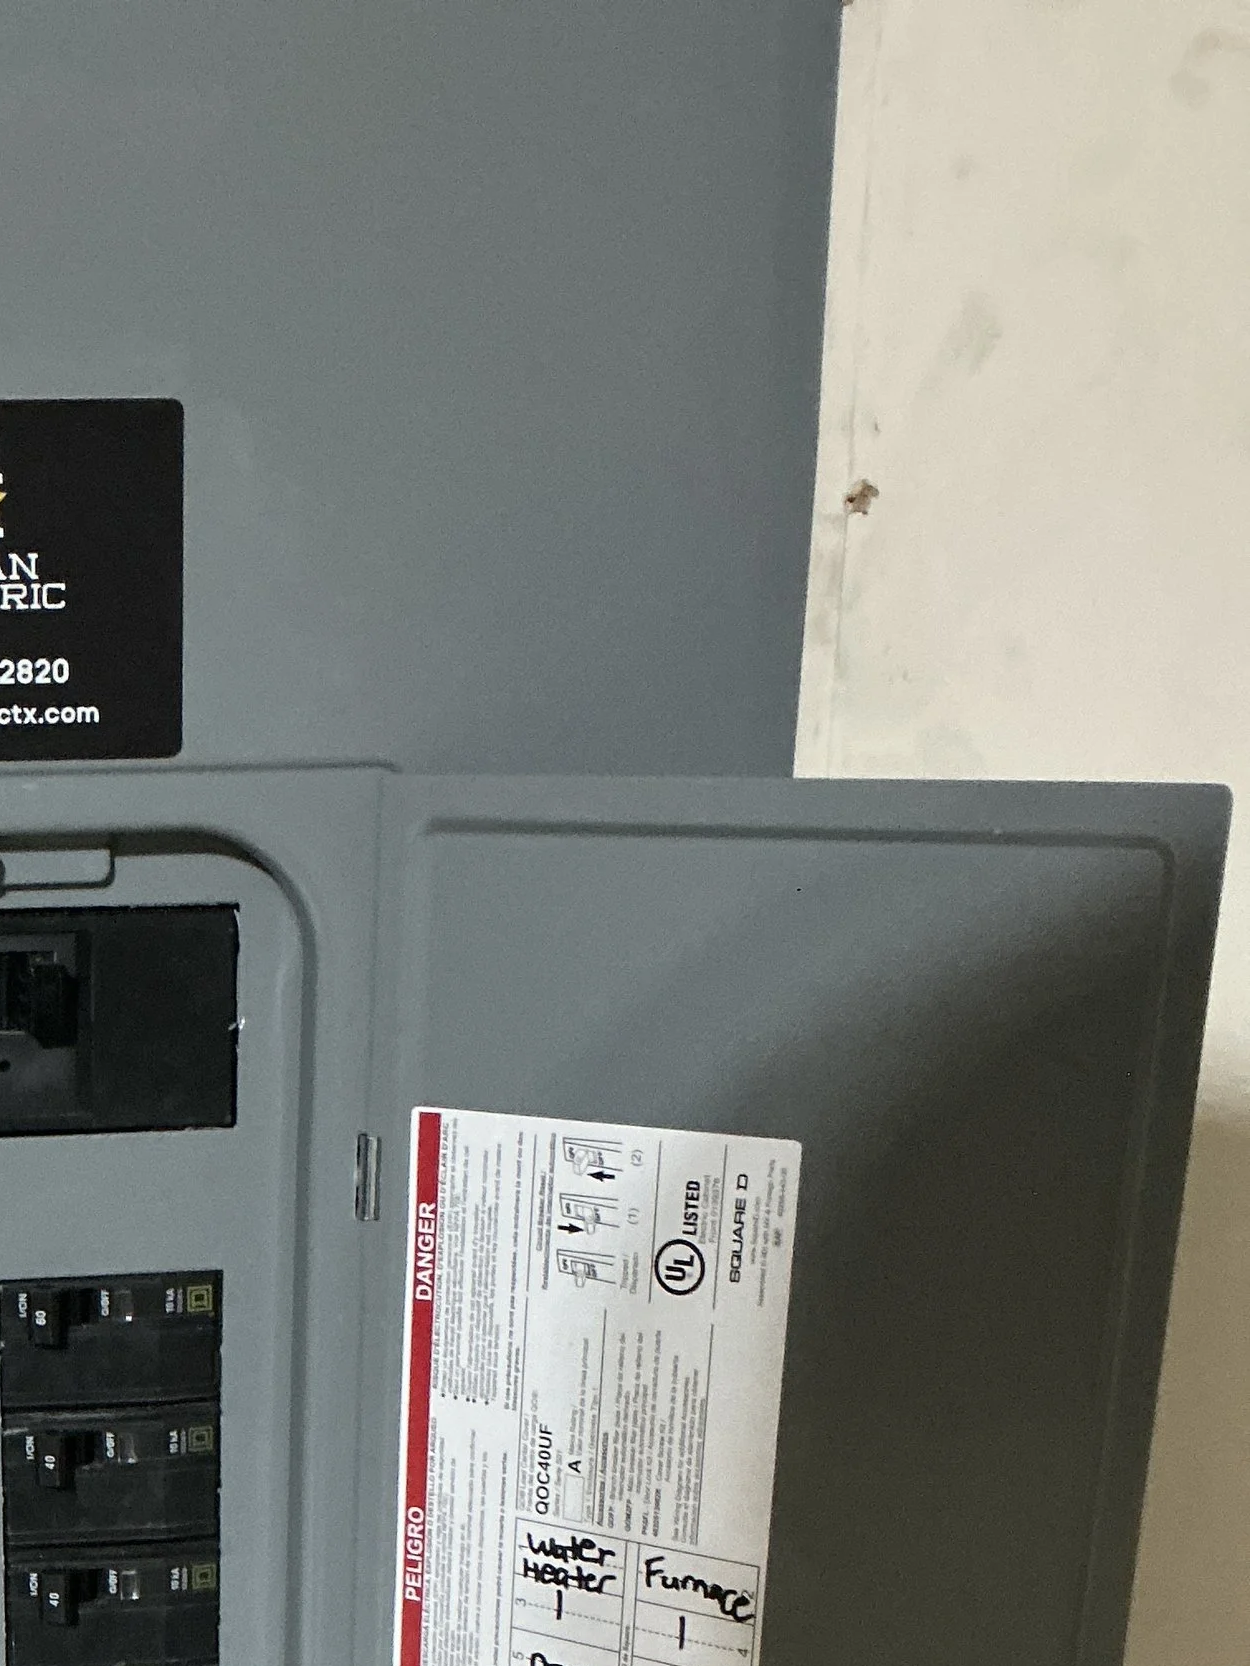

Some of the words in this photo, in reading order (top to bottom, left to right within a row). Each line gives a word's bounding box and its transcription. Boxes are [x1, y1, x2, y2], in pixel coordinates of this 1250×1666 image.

[630, 1149, 644, 1167] (2)
[734, 1173, 749, 1191] D
[628, 1207, 640, 1225] (1)
[681, 1180, 701, 1235] LISTED
[728, 1196, 747, 1284] SQUARE
[416, 1202, 436, 1300] DANGER
[664, 1254, 696, 1282] UL
[35, 1310, 47, 1326] 60
[44, 1455, 56, 1470] 40
[536, 1423, 554, 1515] QOC40UF
[569, 1459, 583, 1474] A
[405, 1506, 425, 1602] PELIGRO
[523, 1558, 617, 1593] Heater
[644, 1556, 756, 1623] Furnace
[49, 1592, 60, 1608] 40
[515, 1596, 526, 1607] 3
[513, 1650, 524, 1661] 5
[736, 1647, 749, 1658] 4
